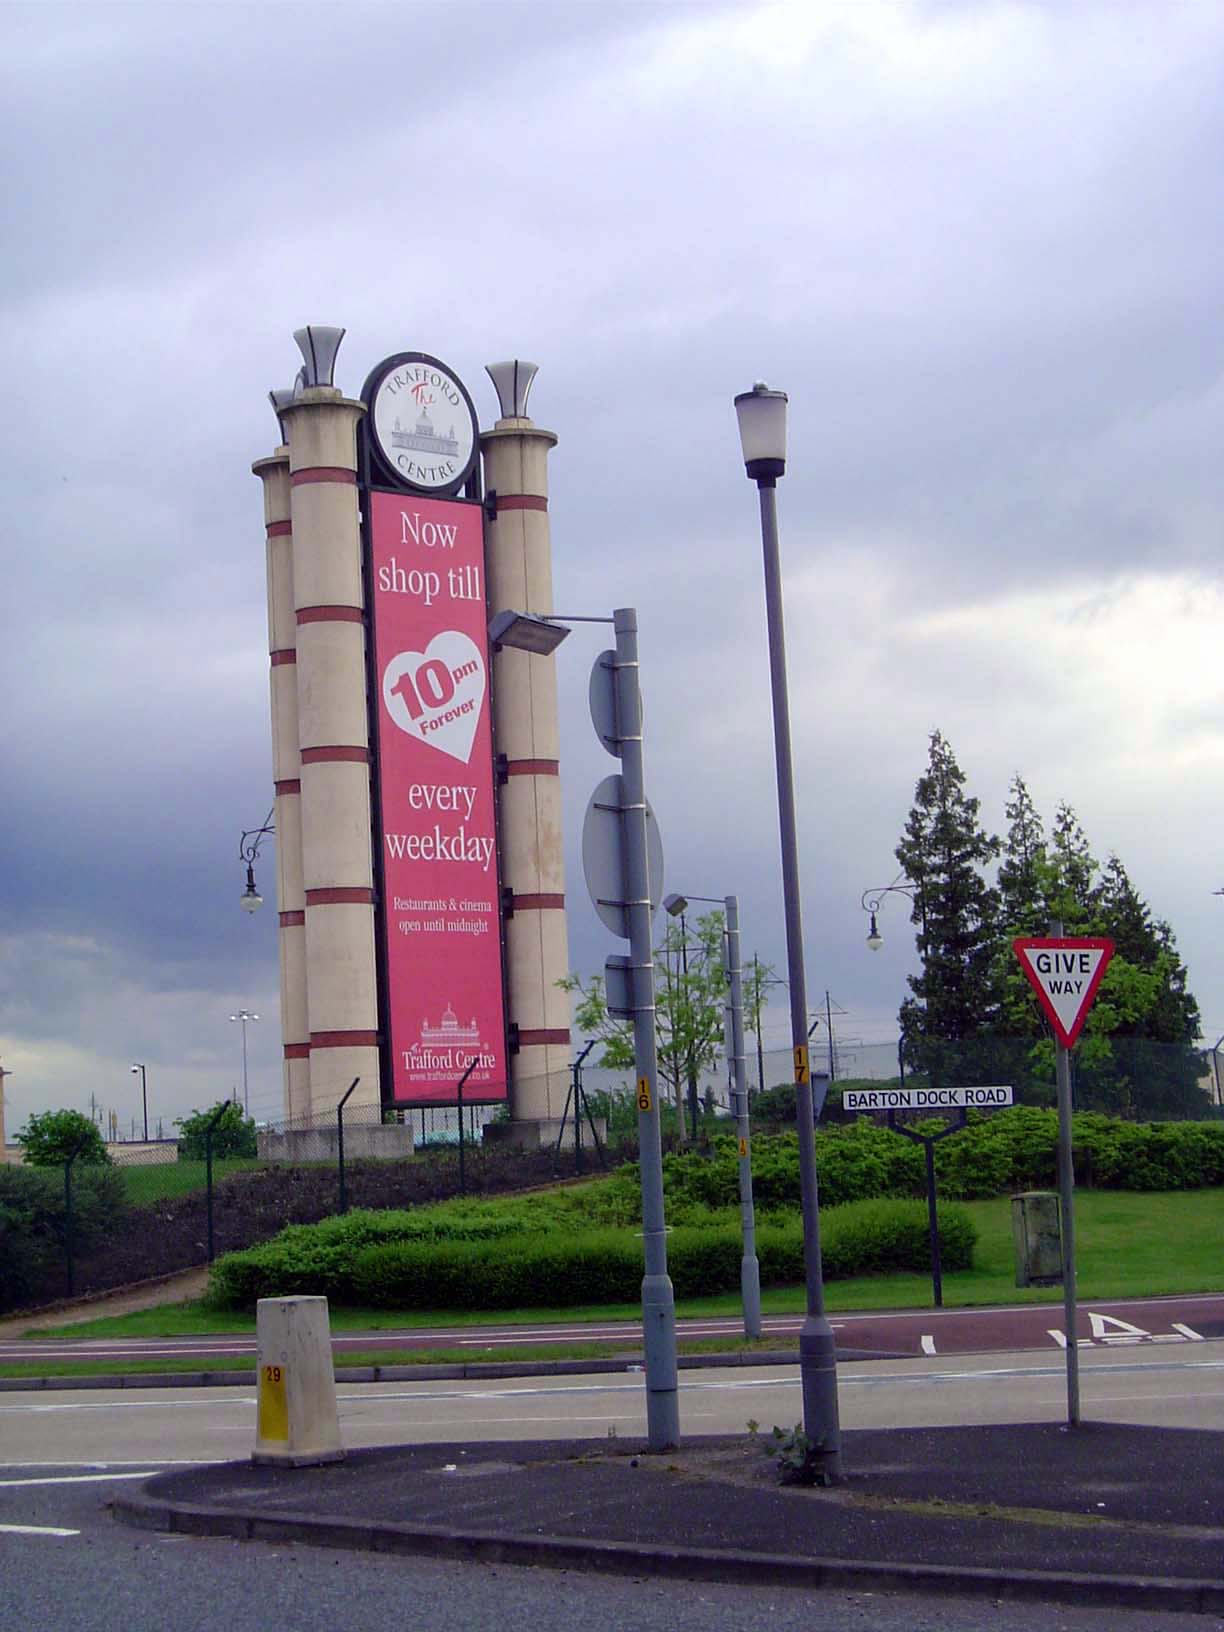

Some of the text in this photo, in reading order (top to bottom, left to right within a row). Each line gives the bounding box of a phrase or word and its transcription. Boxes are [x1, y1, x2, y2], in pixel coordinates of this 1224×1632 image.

[385, 367, 460, 406] TRAFFORD
[397, 454, 455, 481] CENTRE
[400, 511, 457, 549] Now
[379, 557, 481, 606] shop till
[419, 698, 475, 736] Forever
[408, 783, 477, 821] every
[385, 824, 495, 872] weekday
[393, 896, 492, 912] Restaurants & cinema
[399, 917, 488, 936] open until midnight
[1036, 953, 1091, 974] GIVE
[1048, 981, 1083, 994] WAY
[402, 1049, 453, 1070] Trafford
[848, 1088, 1007, 1108] BARTON DOCK ROAD
[266, 1365, 281, 1382] 29
